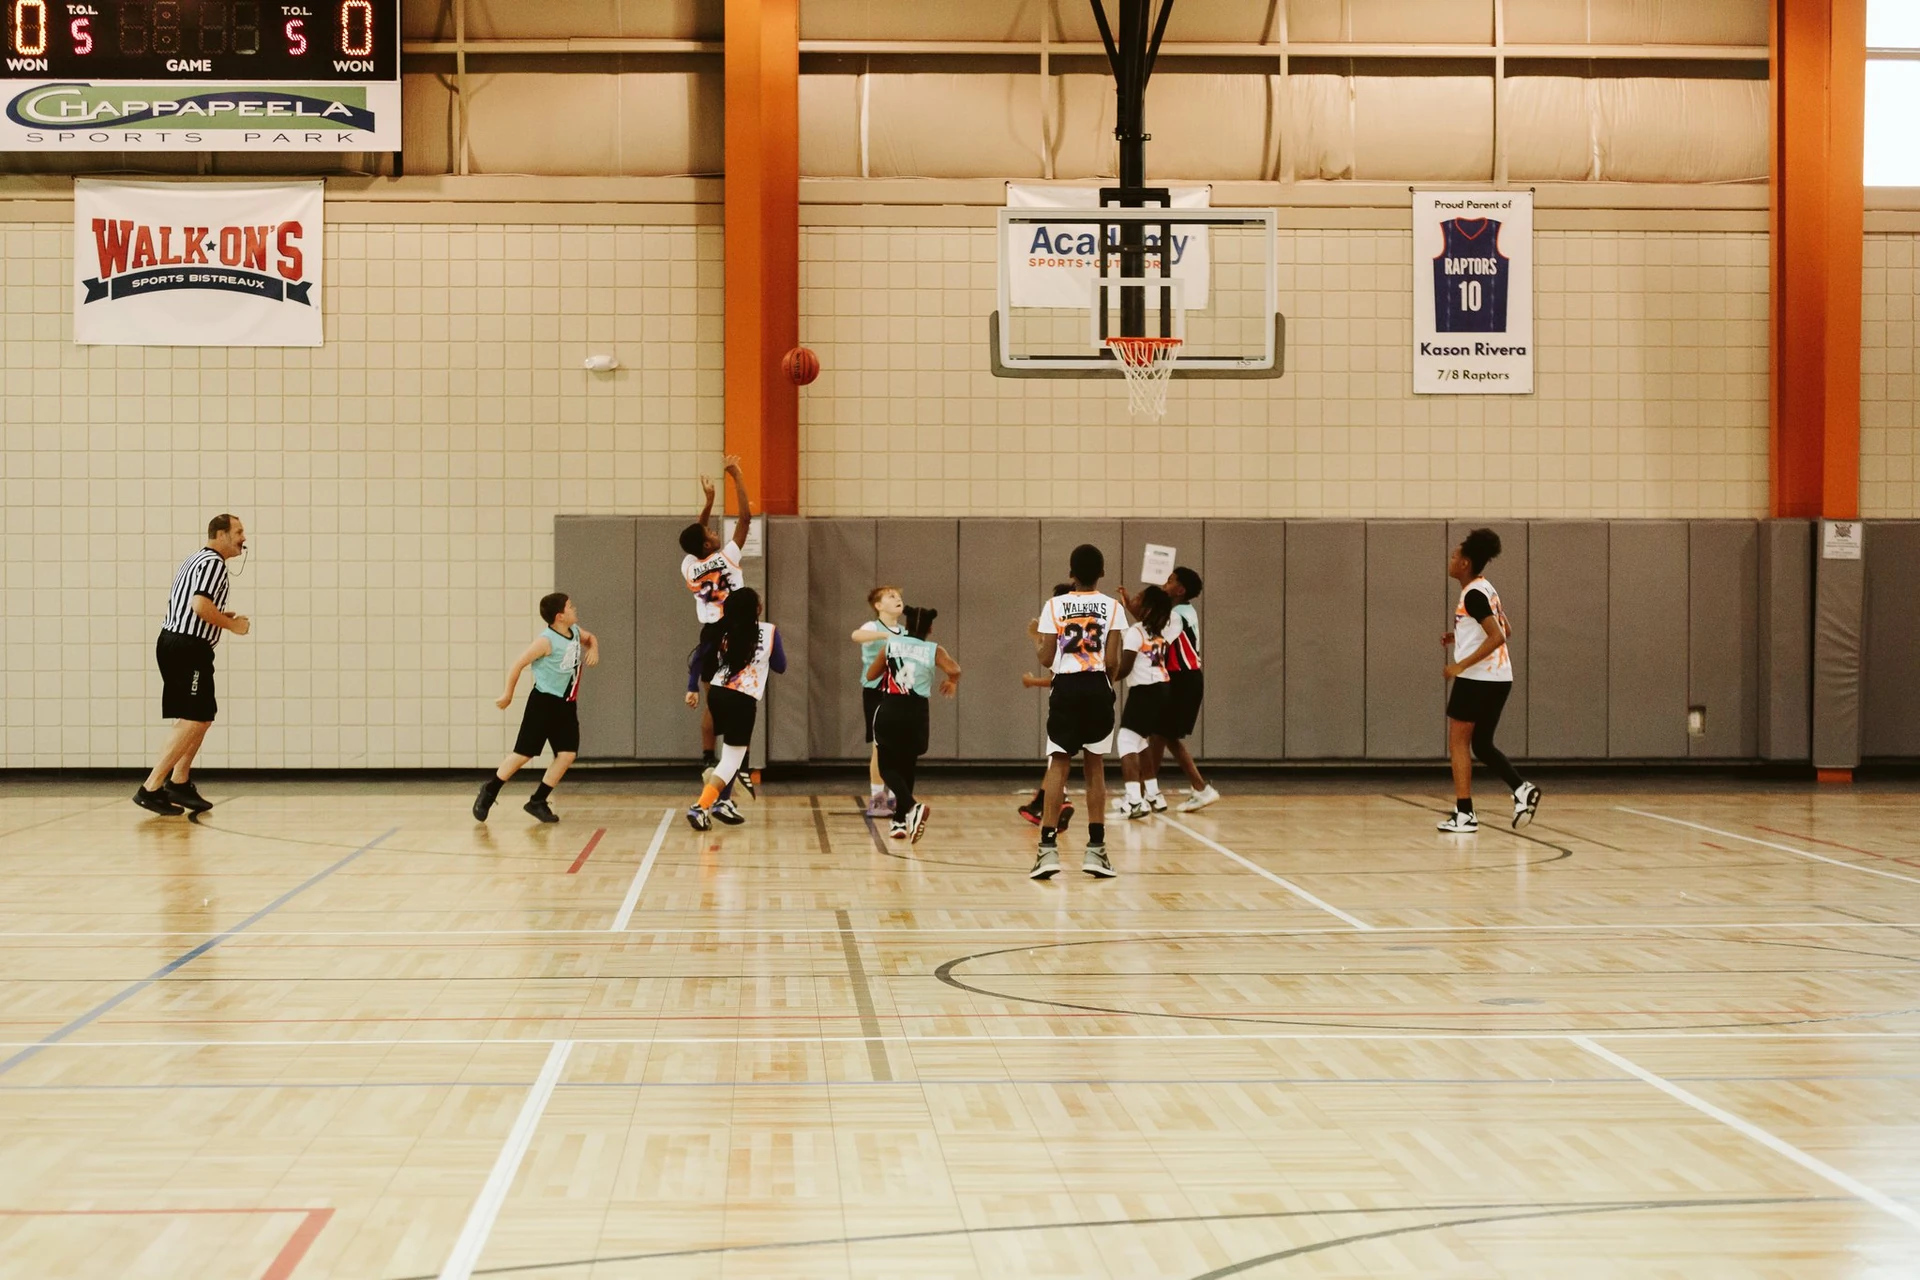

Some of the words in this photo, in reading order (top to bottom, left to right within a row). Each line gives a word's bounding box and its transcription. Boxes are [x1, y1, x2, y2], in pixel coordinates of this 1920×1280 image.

[67, 4, 99, 15] T.O.L.
[281, 6, 313, 16] T.O.L.
[341, 0, 373, 56] 0
[6, 58, 49, 72] WON
[166, 59, 212, 72] GAME
[333, 60, 375, 73] WON
[25, 88, 354, 123] CHAPPAPEELA
[26, 132, 203, 143] SPORTS
[244, 132, 355, 143] PARK
[1434, 200, 1464, 209] Proud
[1466, 200, 1499, 209] Parent
[1501, 200, 1512, 209] of
[1029, 226, 1189, 266] Acadmy
[1444, 257, 1498, 276] RAPTORS
[131, 274, 185, 288] SPORTS
[188, 274, 265, 290] BISTREAUX
[1458, 280, 1482, 312] 10
[1420, 342, 1470, 356] Kason
[1475, 342, 1527, 356] Rivera
[1437, 369, 1459, 381] 7/8
[1462, 369, 1510, 382] Raptors
[1063, 622, 1104, 654] 23
